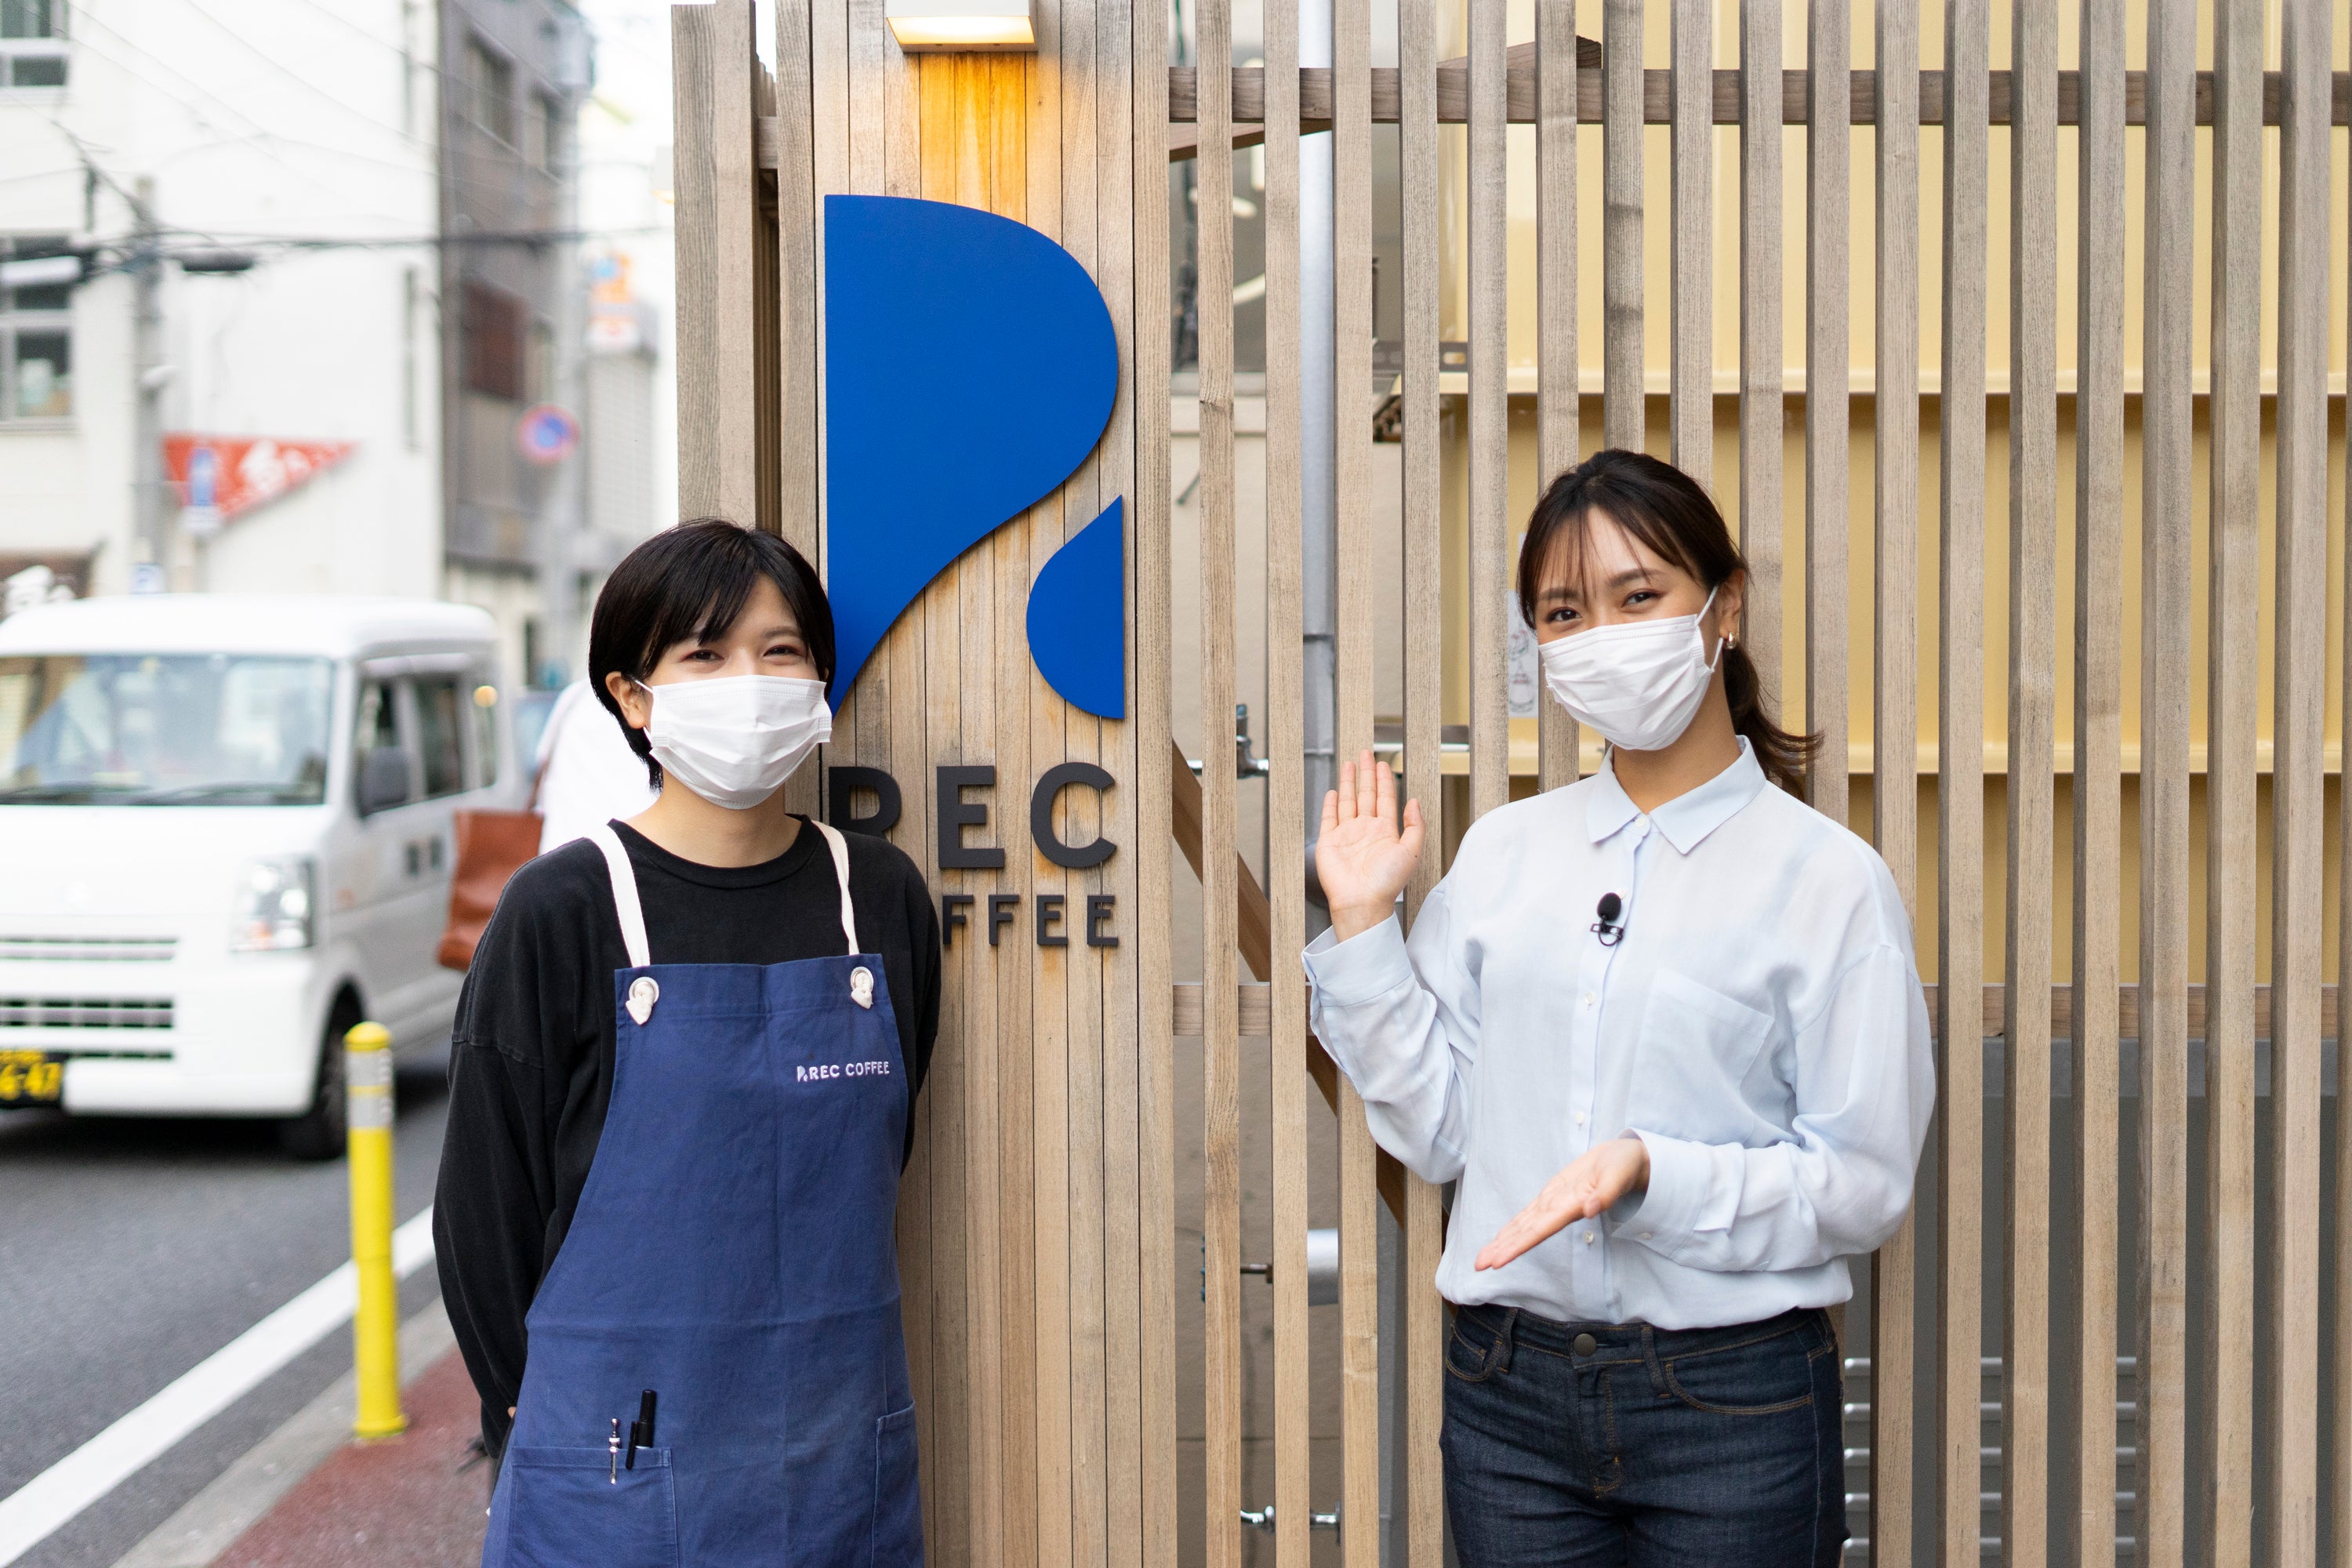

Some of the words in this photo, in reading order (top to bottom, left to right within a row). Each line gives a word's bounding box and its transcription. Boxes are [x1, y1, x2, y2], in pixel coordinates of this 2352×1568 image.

[828, 761, 1118, 868] REC
[942, 894, 1120, 946] FFEE
[845, 1061, 890, 1076] COFFEE
